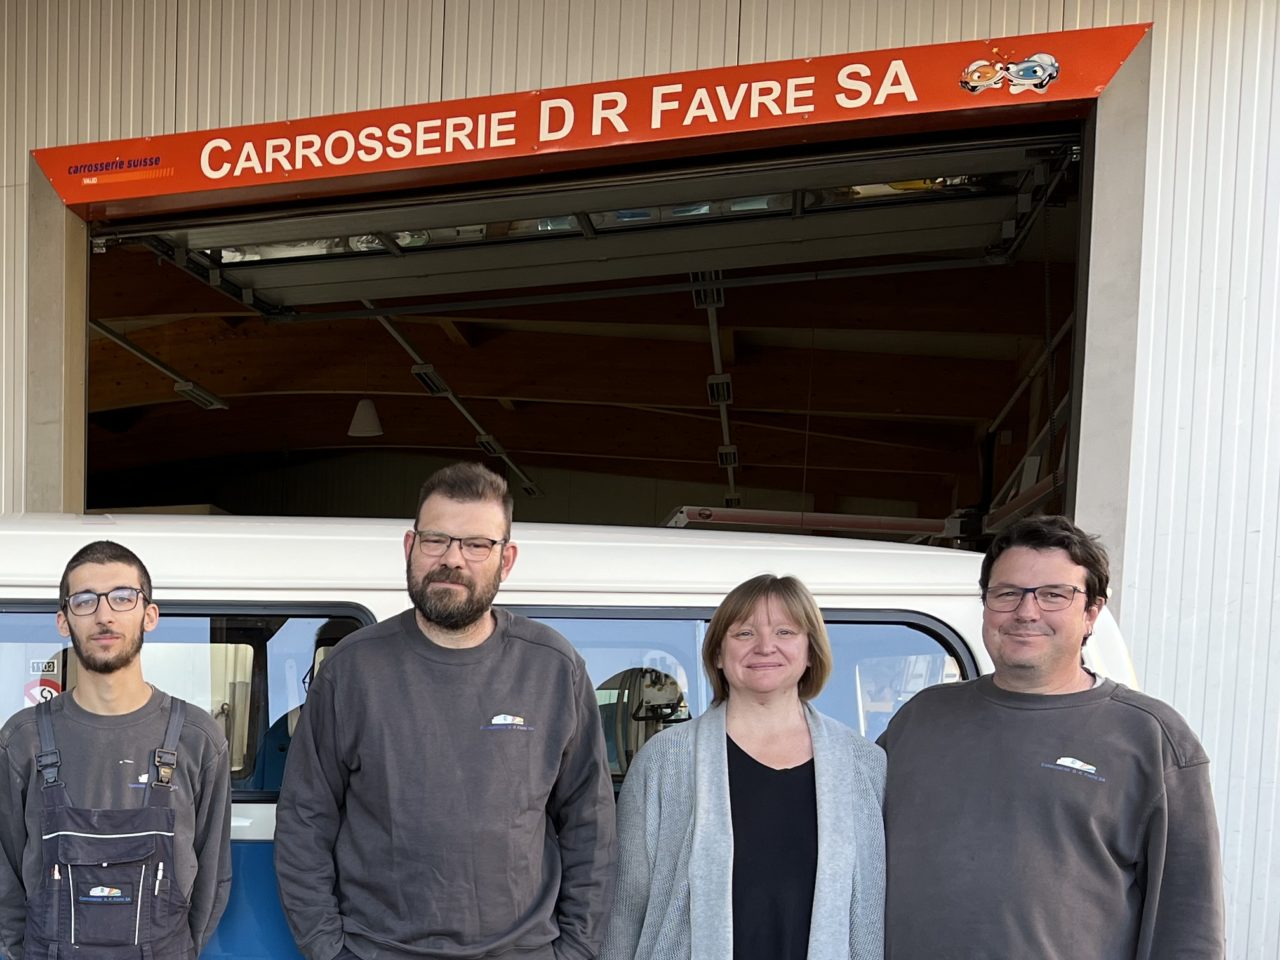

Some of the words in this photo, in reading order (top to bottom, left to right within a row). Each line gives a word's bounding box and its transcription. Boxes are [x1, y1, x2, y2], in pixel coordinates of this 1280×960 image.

[200, 111, 517, 180] CARROSSERIE
[539, 98, 575, 142] D
[591, 91, 630, 136] R
[651, 75, 816, 129] FAVRE
[835, 59, 919, 109] SA
[67, 159, 125, 176] carrosserie
[127, 156, 161, 169] suisse
[33, 661, 55, 672] 1103
